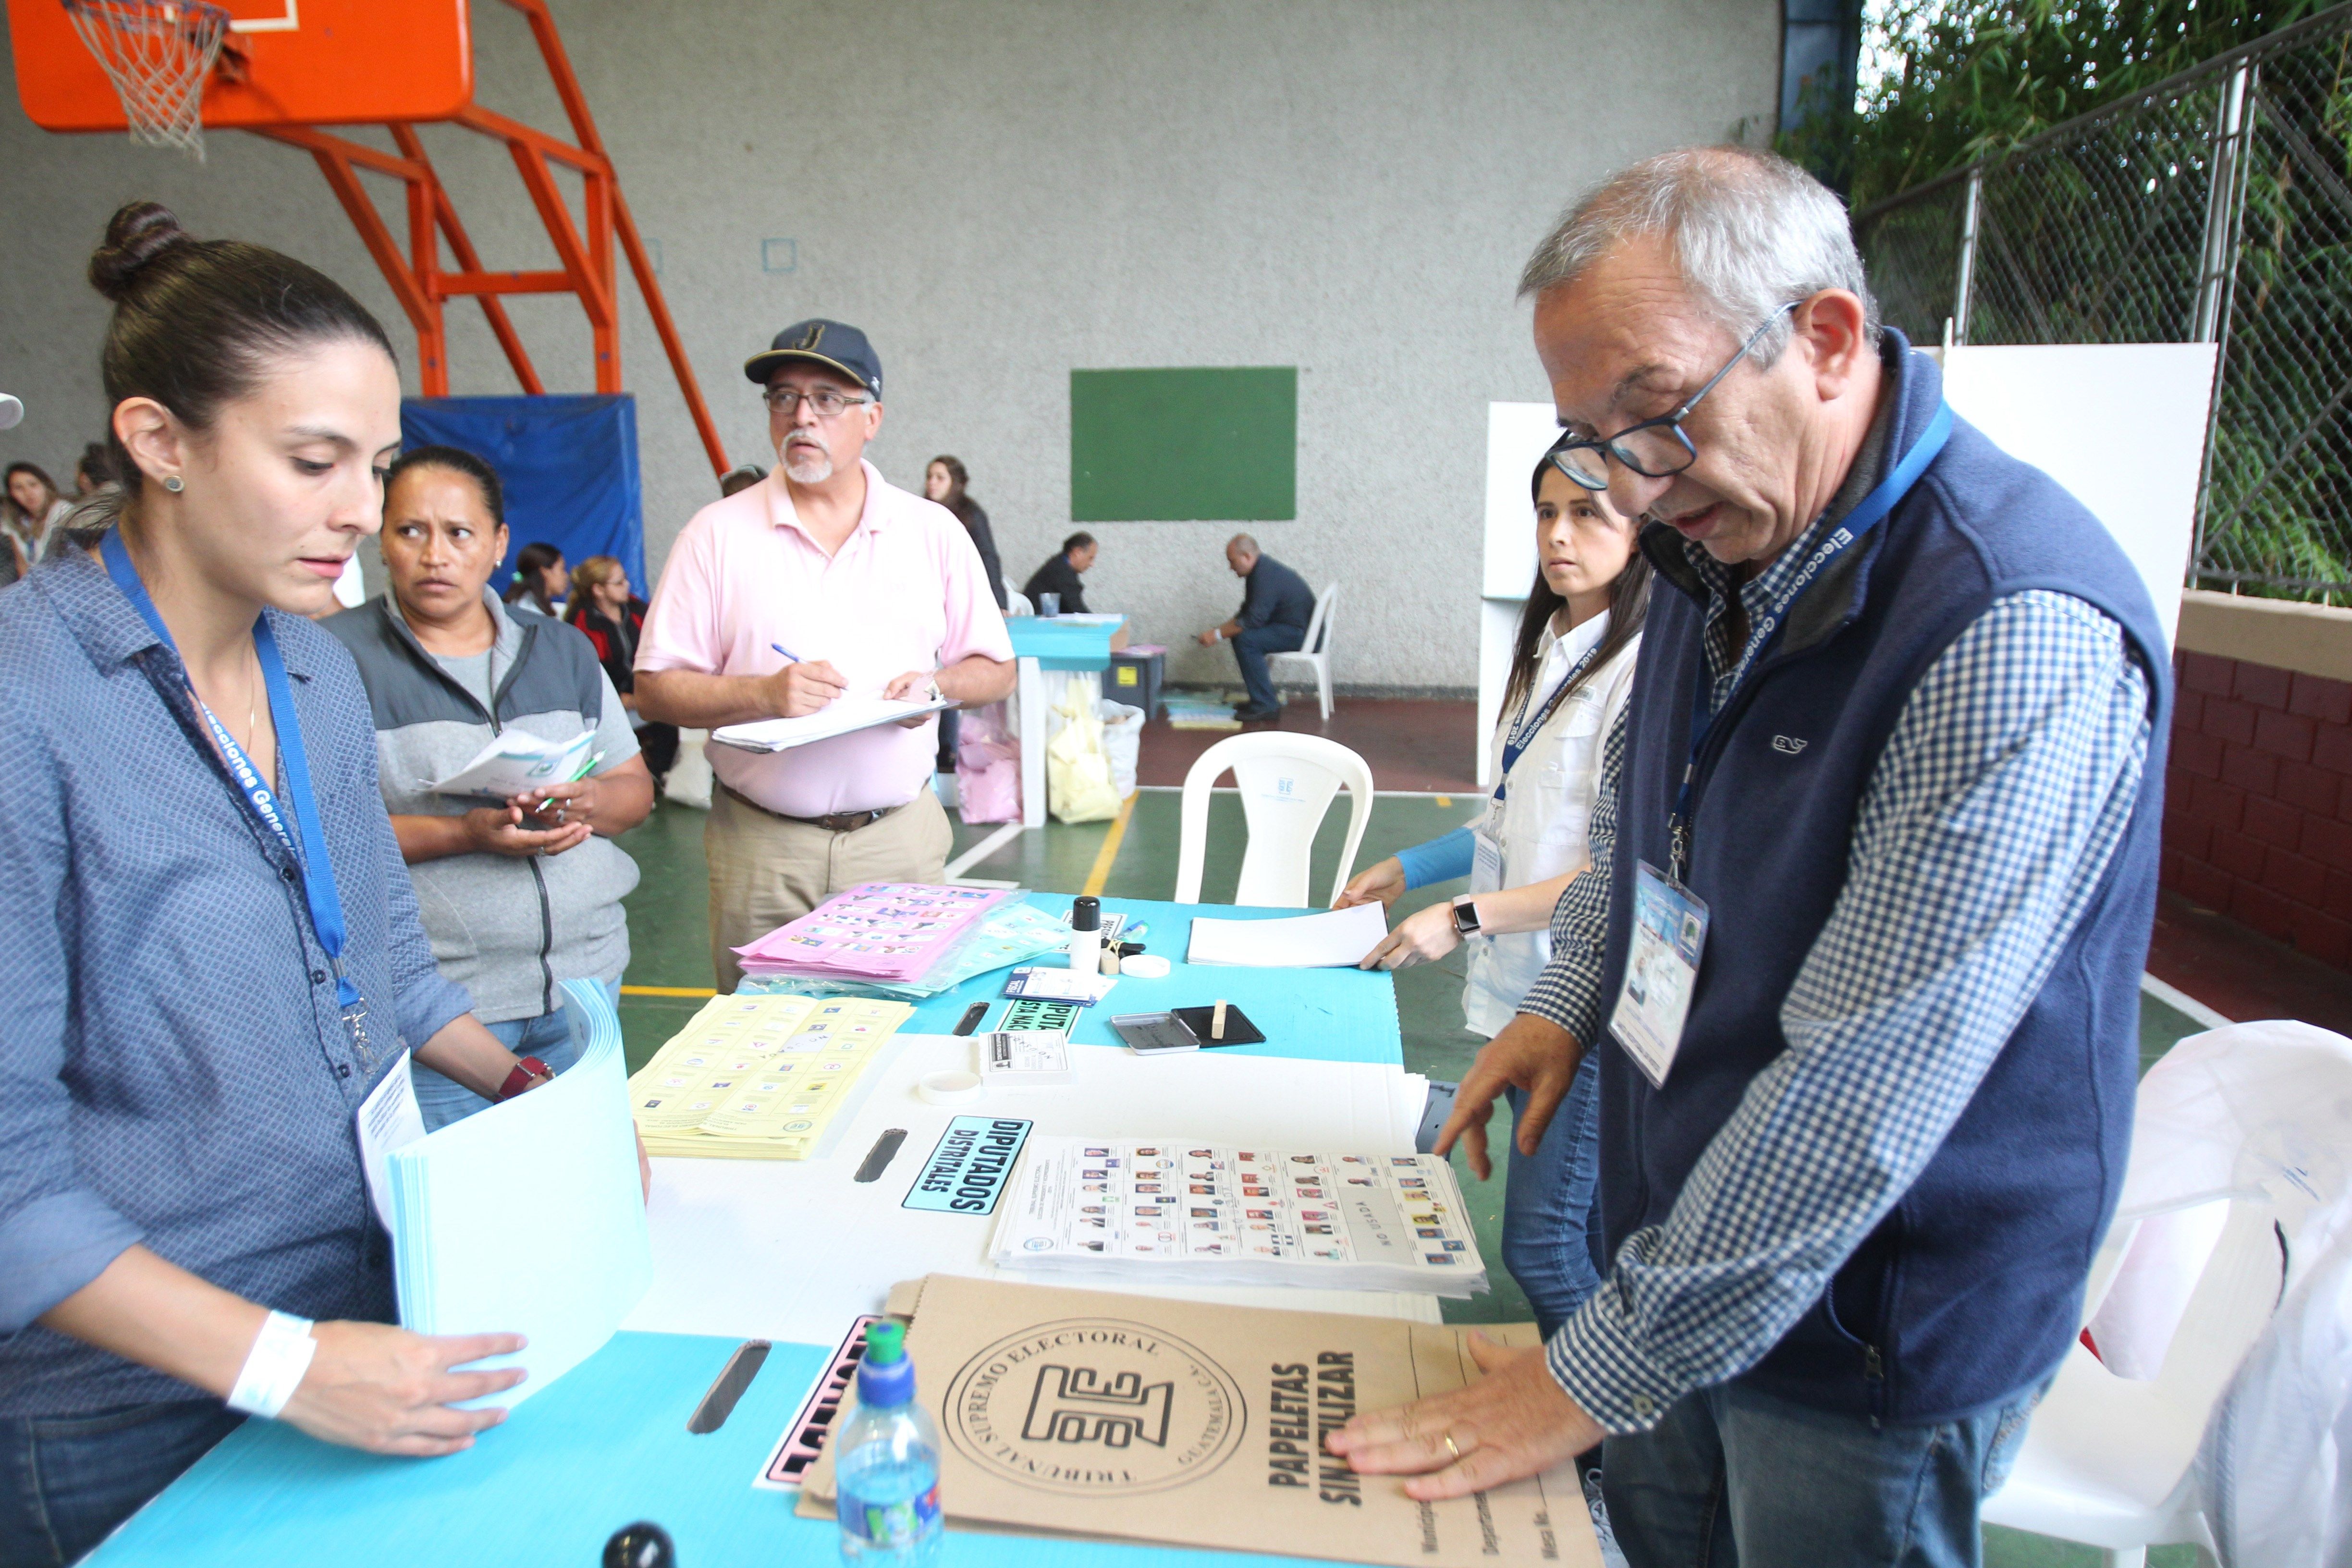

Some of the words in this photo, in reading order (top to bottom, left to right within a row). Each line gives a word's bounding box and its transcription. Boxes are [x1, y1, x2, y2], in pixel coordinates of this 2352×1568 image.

[1775, 527, 1854, 613] Elecciones
[1731, 616, 1776, 690] General
[1515, 708, 1551, 750] Elecciones
[1579, 648, 1597, 668] 2019
[1507, 725, 1519, 745] 2019
[253, 790, 295, 851] General
[1036, 1004, 1073, 1030] IPUTA
[921, 1129, 980, 1192] DISTRITALES
[950, 1120, 1024, 1211] DIPUTADOS
[1356, 1201, 1382, 1230] USADA
[1376, 1233, 1393, 1247] NO
[1007, 1330, 1160, 1364] ELECTORAL
[968, 1361, 1008, 1446] SUPREMO
[1268, 1362, 1310, 1489] PAPELETAS
[995, 1446, 1138, 1483] TRIBUNAL
[1319, 1465, 1362, 1507] SIN
[1416, 1498, 1439, 1554] Municipi
